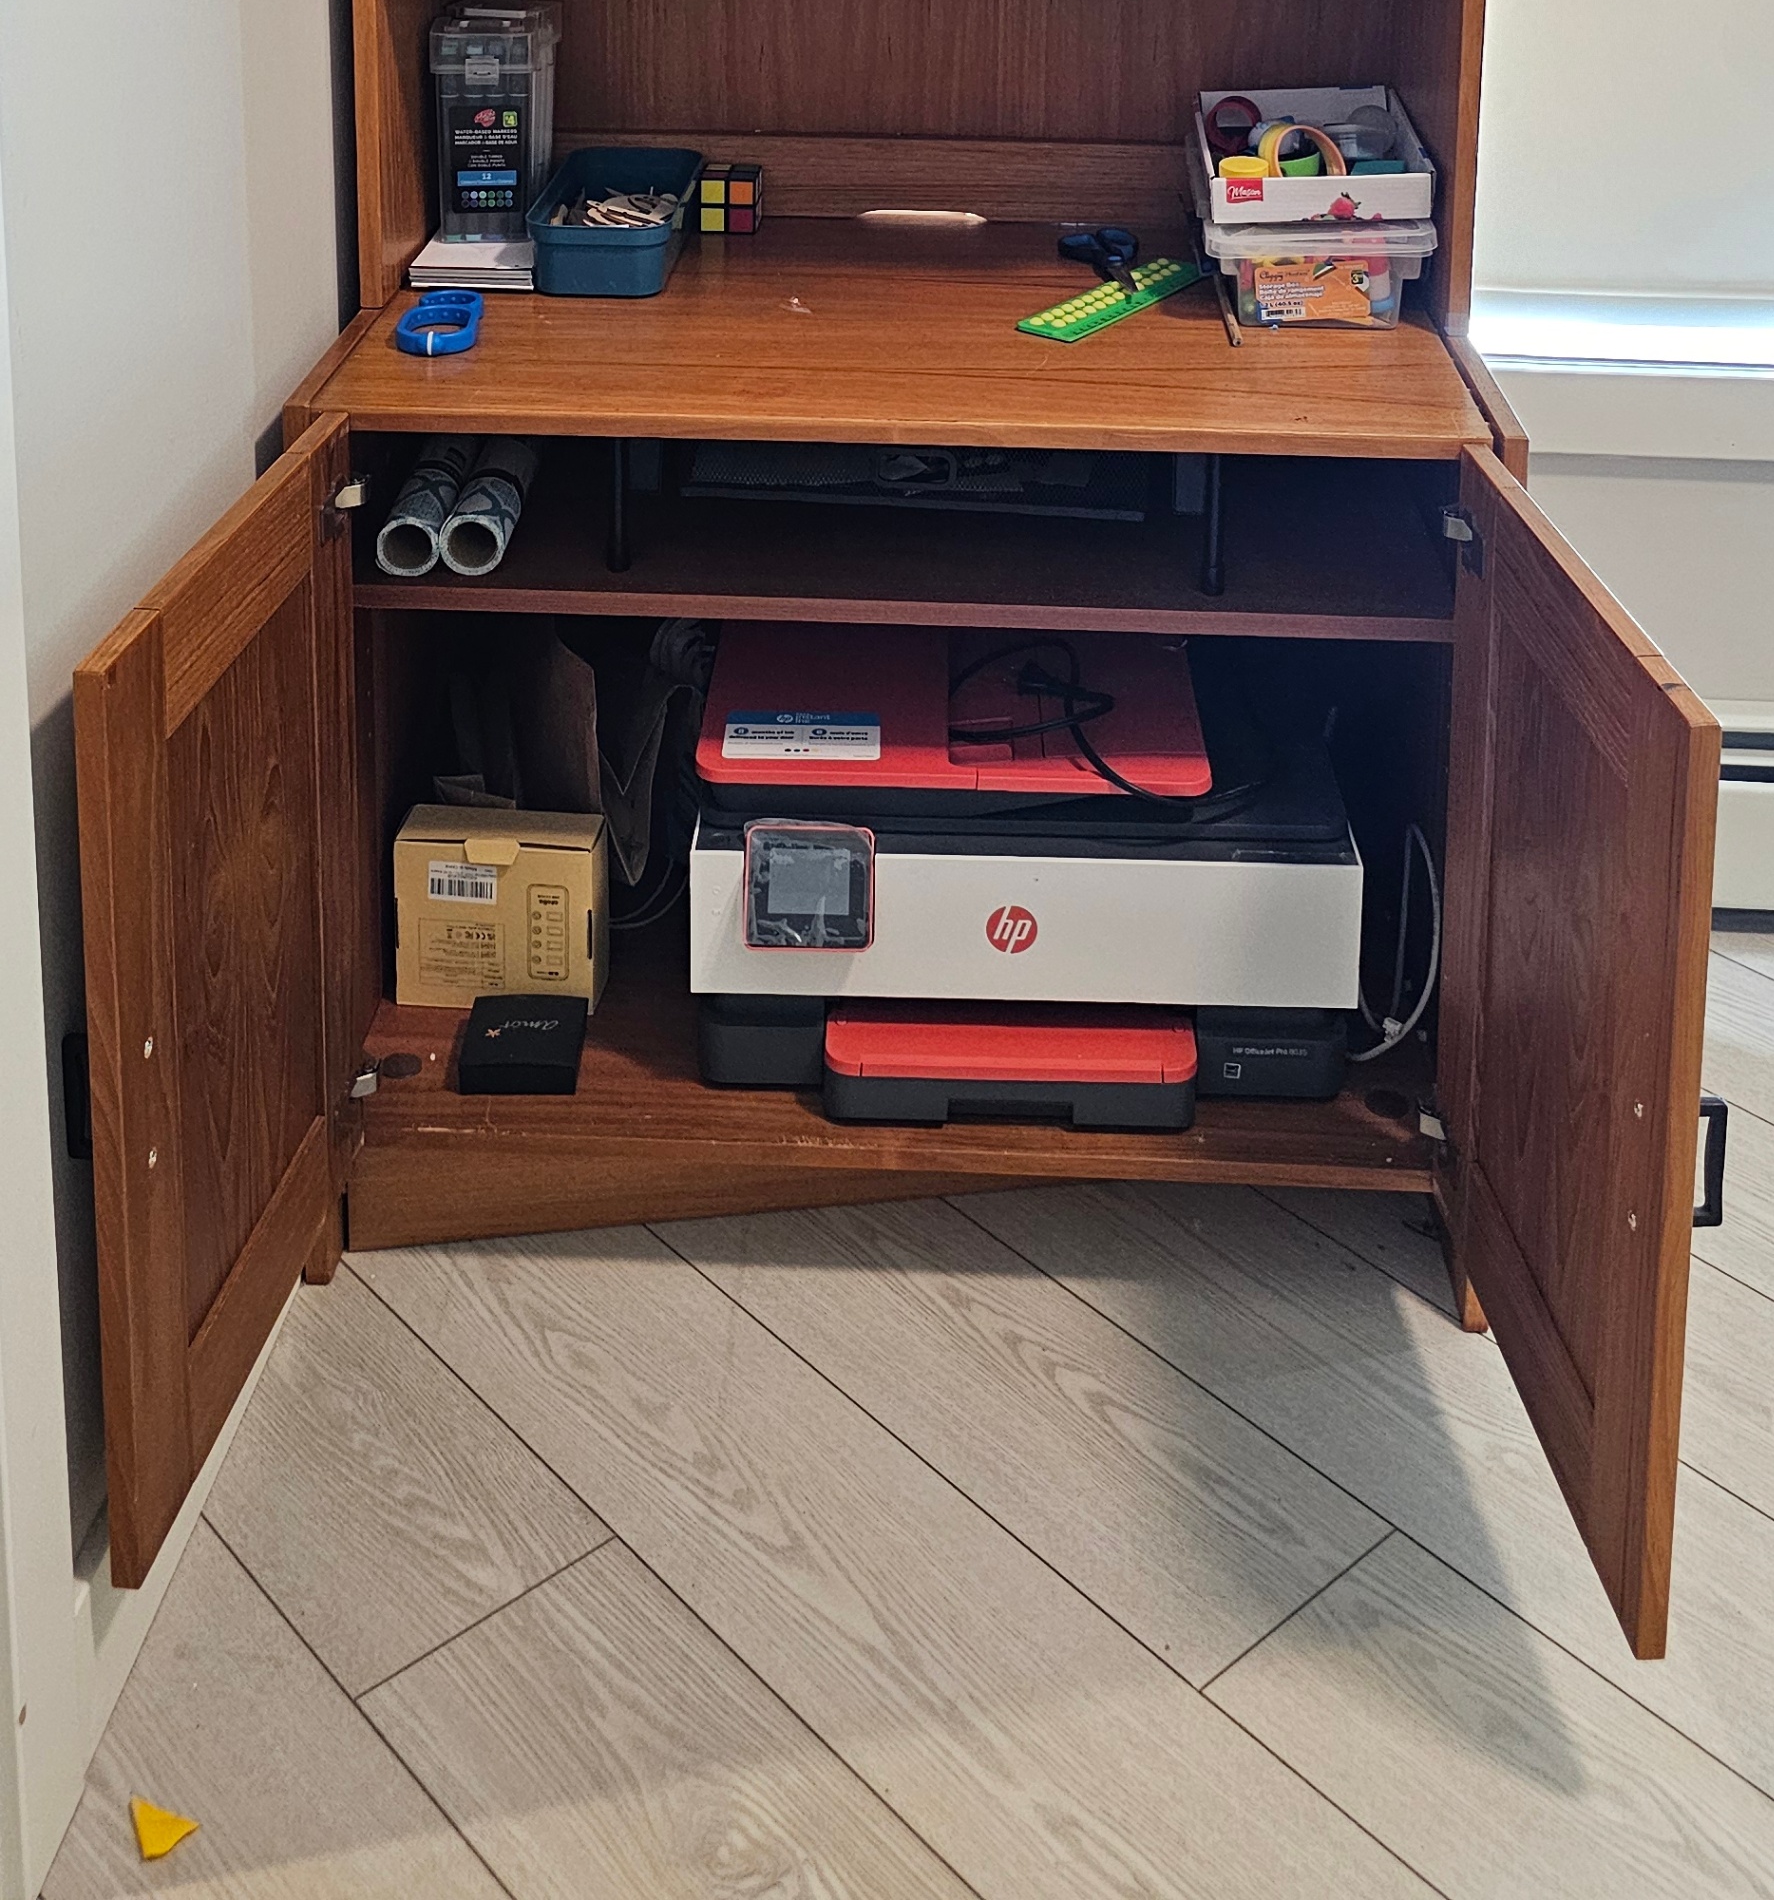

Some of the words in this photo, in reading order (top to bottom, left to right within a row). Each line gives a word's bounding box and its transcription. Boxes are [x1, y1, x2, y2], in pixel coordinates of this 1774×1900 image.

[1227, 186, 1262, 200] Mason
[989, 906, 1035, 953] hp
[500, 1019, 559, 1031] amor
